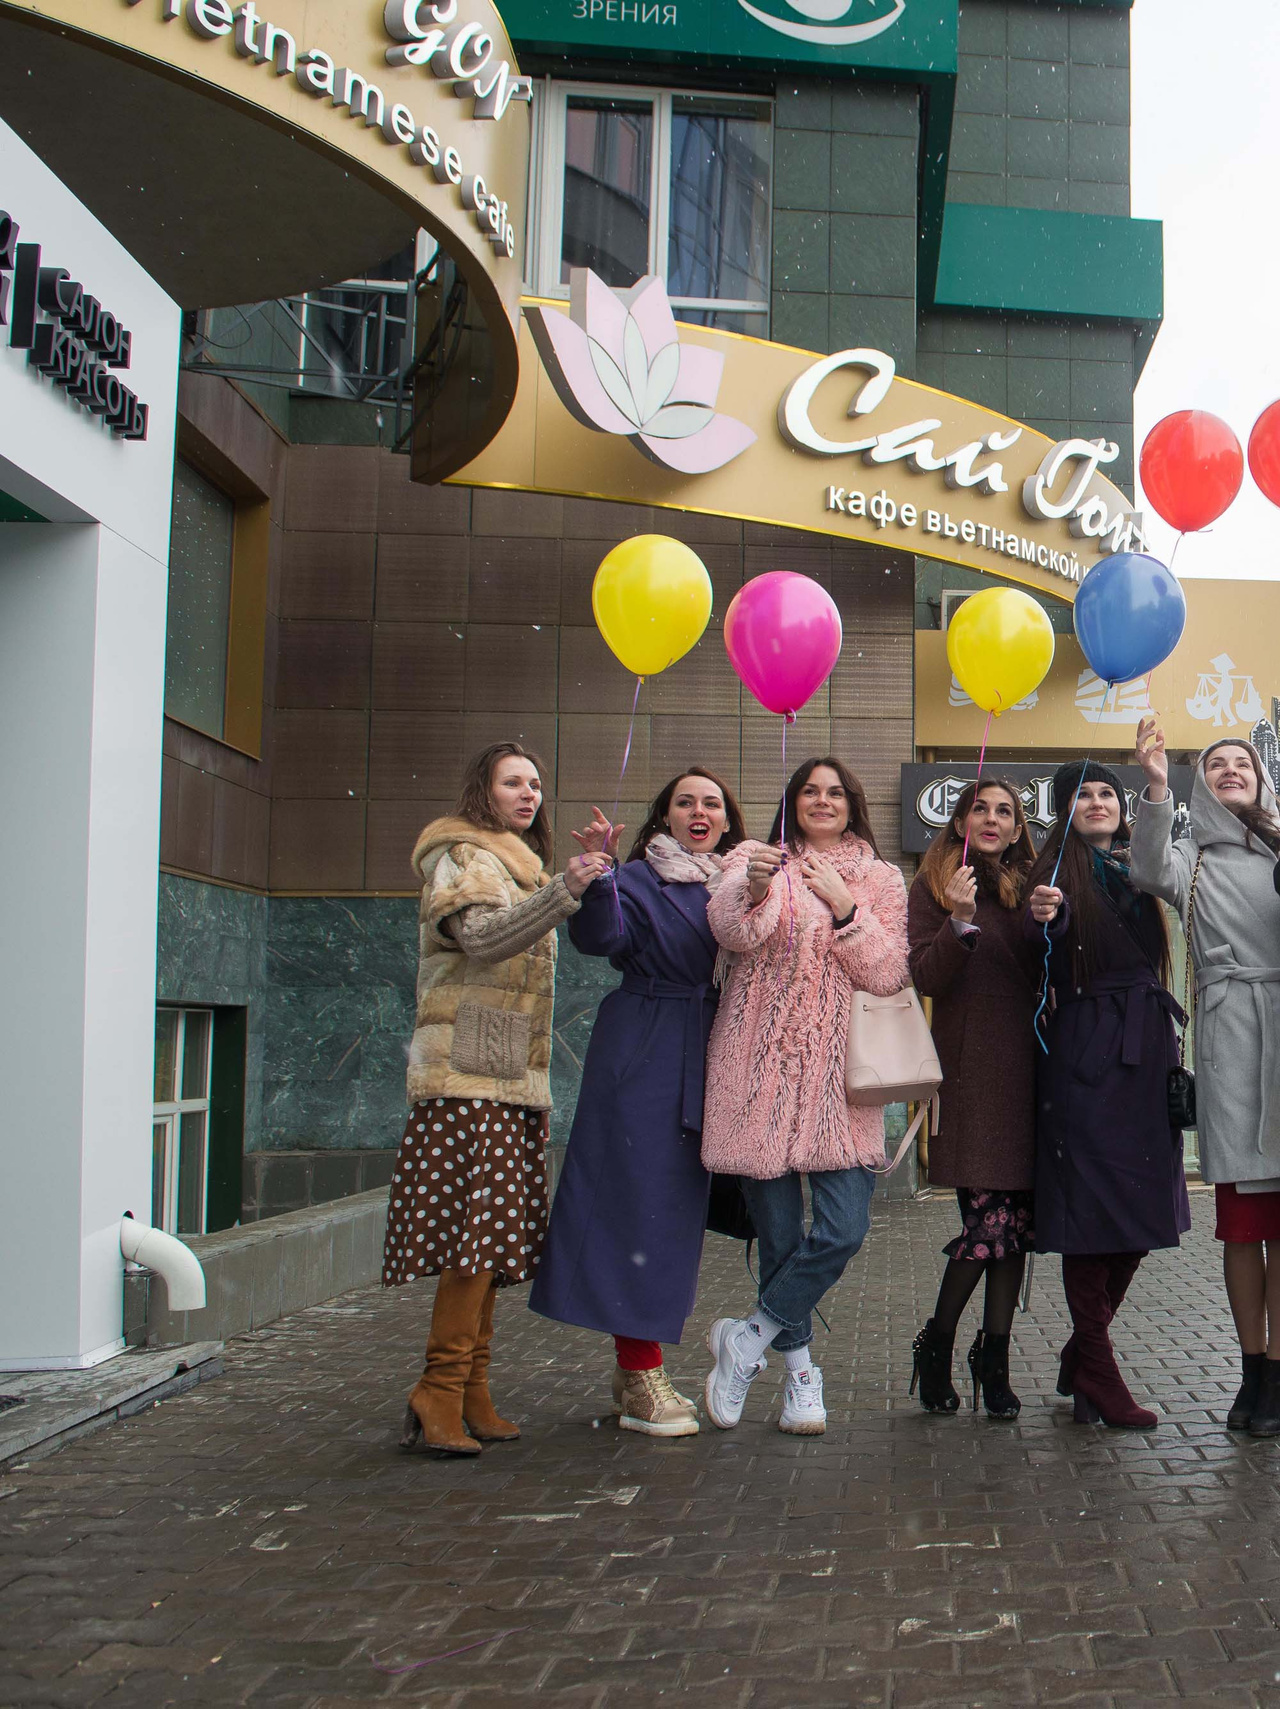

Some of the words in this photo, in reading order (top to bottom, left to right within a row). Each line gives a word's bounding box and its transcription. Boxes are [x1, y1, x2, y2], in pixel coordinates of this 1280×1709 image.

[572, 0, 678, 26] ЗРЕНИЯ
[463, 174, 515, 259] cafe
[37, 267, 132, 369] САЛОН
[29, 323, 149, 441] КРАСОТЫ
[778, 348, 1022, 494] Сай
[826, 484, 918, 529] кафе
[923, 508, 1080, 584] вьетнамской
